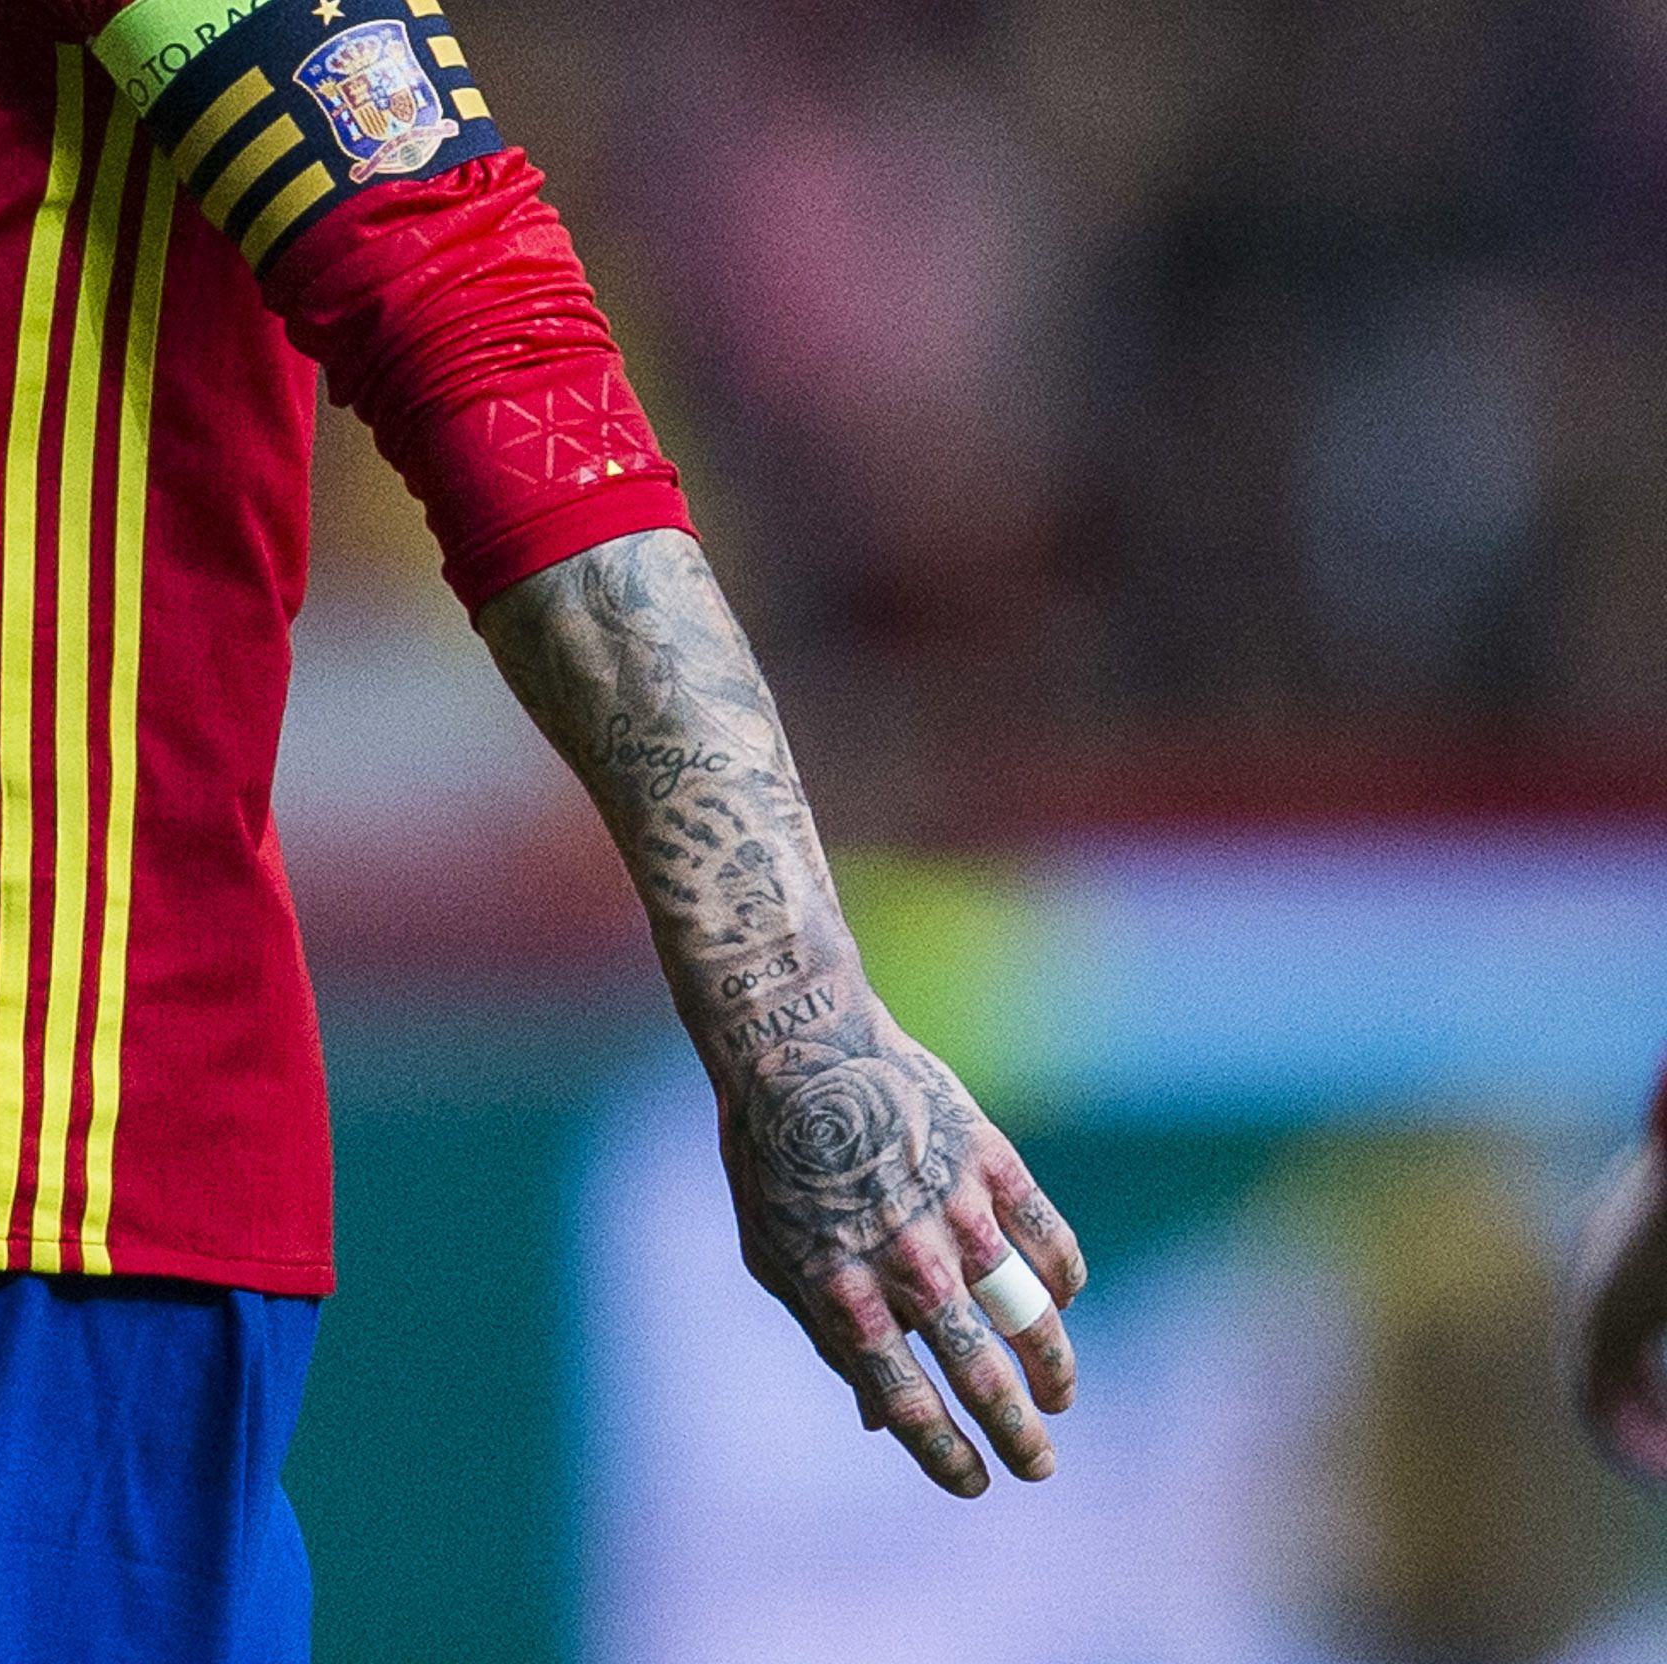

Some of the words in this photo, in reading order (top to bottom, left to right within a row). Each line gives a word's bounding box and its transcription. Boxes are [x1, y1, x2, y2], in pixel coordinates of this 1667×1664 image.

[140, 42, 192, 86] TO
[597, 712, 736, 800] Sergio
[723, 985, 836, 1054] MMXIV
